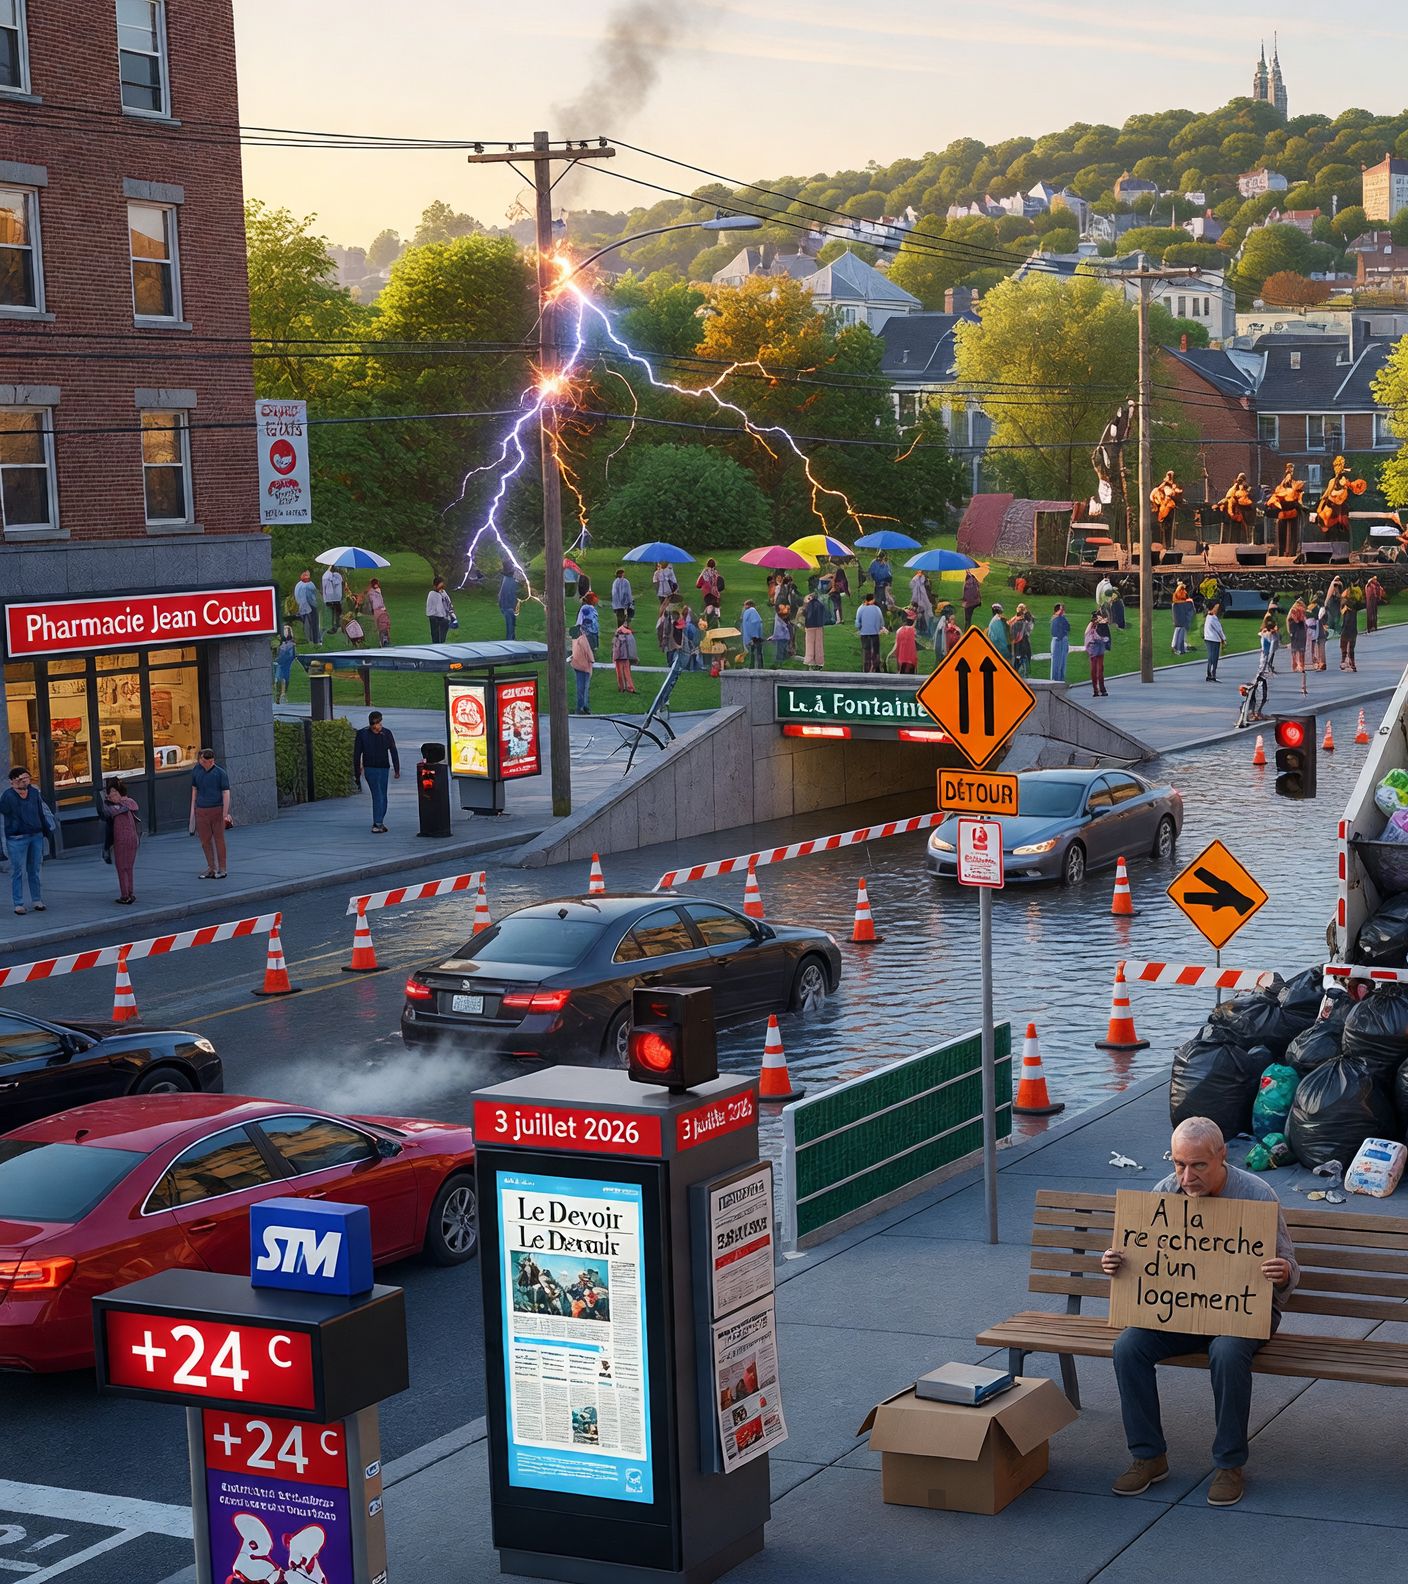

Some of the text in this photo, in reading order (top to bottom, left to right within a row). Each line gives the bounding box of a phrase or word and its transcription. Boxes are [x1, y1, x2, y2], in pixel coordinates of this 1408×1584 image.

[26, 600, 260, 641] Pharmacie Jean Coutu
[946, 778, 1012, 804] DÉTOUR
[494, 1110, 640, 1144] 3 juillet 2026
[518, 1197, 623, 1229] Le Devoir
[1184, 1200, 1204, 1229] la
[257, 1225, 343, 1279] STM
[519, 1225, 545, 1249] Le
[1144, 1250, 1196, 1280] d'un
[1137, 1276, 1257, 1323] logement
[131, 1324, 292, 1392] +24 C
[213, 1420, 338, 1474] +24 C
